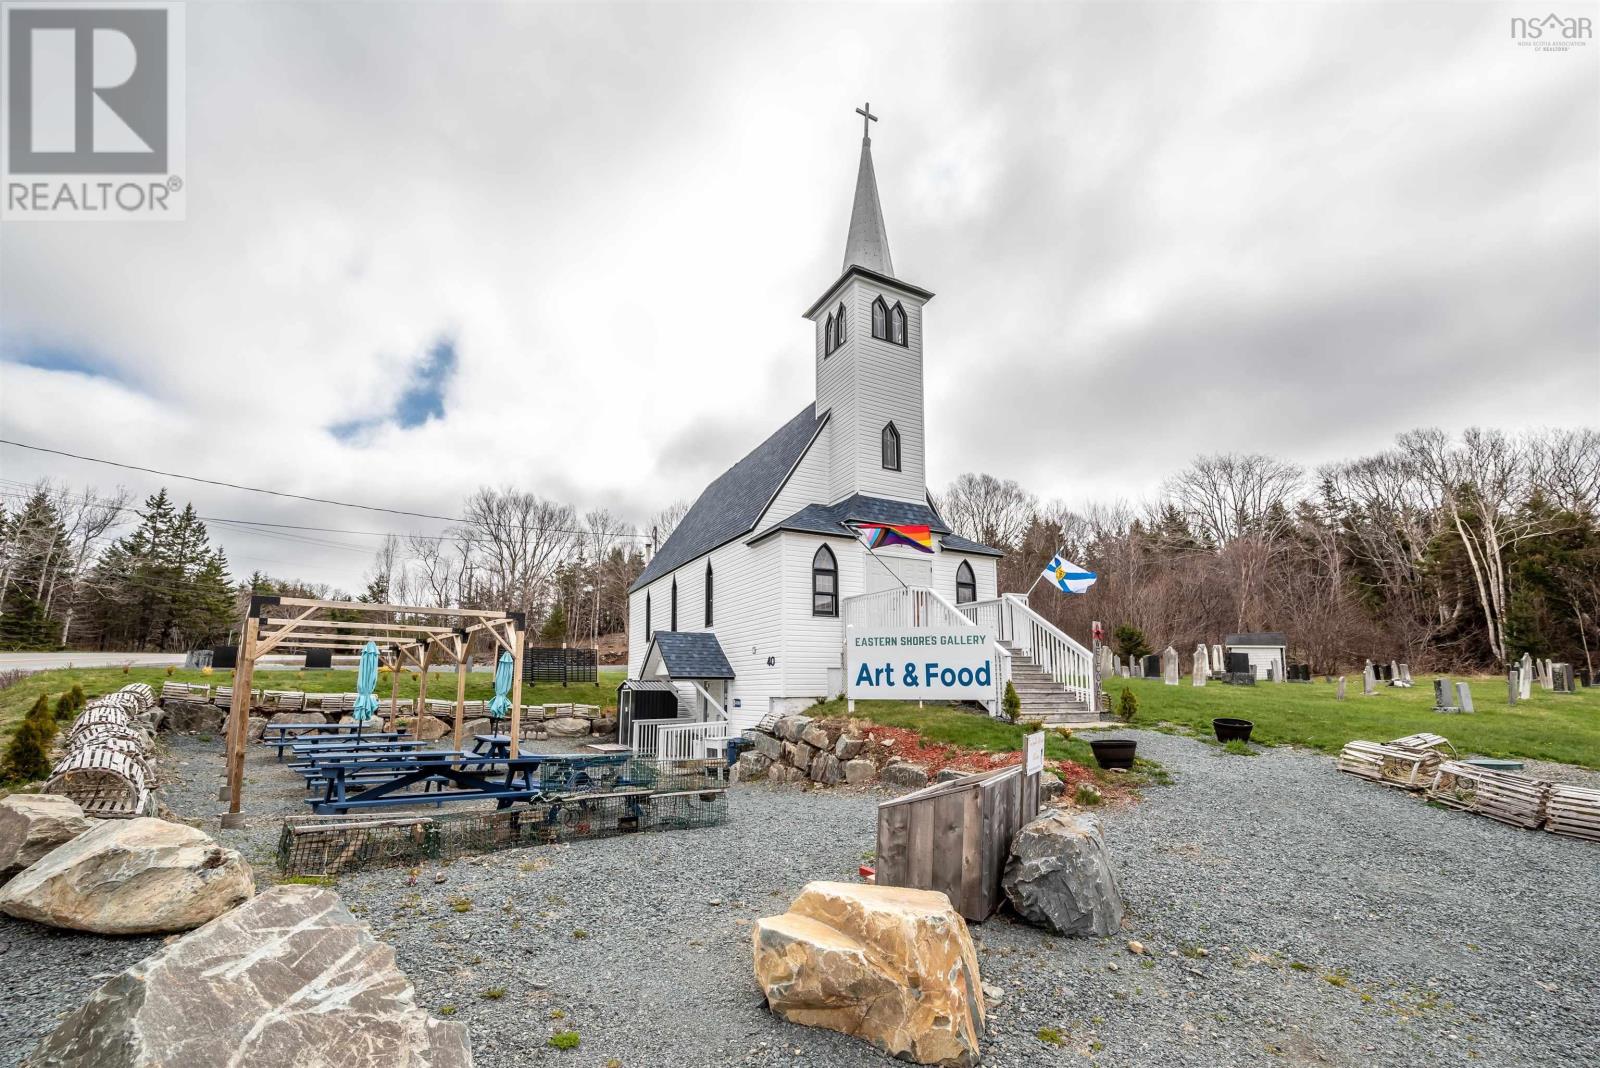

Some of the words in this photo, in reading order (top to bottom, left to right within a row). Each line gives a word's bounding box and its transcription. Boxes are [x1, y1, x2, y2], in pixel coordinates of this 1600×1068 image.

[855, 637, 897, 647] EASTERN
[940, 635, 986, 646] GALLERY
[767, 656, 776, 666] 40
[855, 662, 895, 687] Art
[902, 662, 919, 687] &
[925, 660, 991, 687] Food
